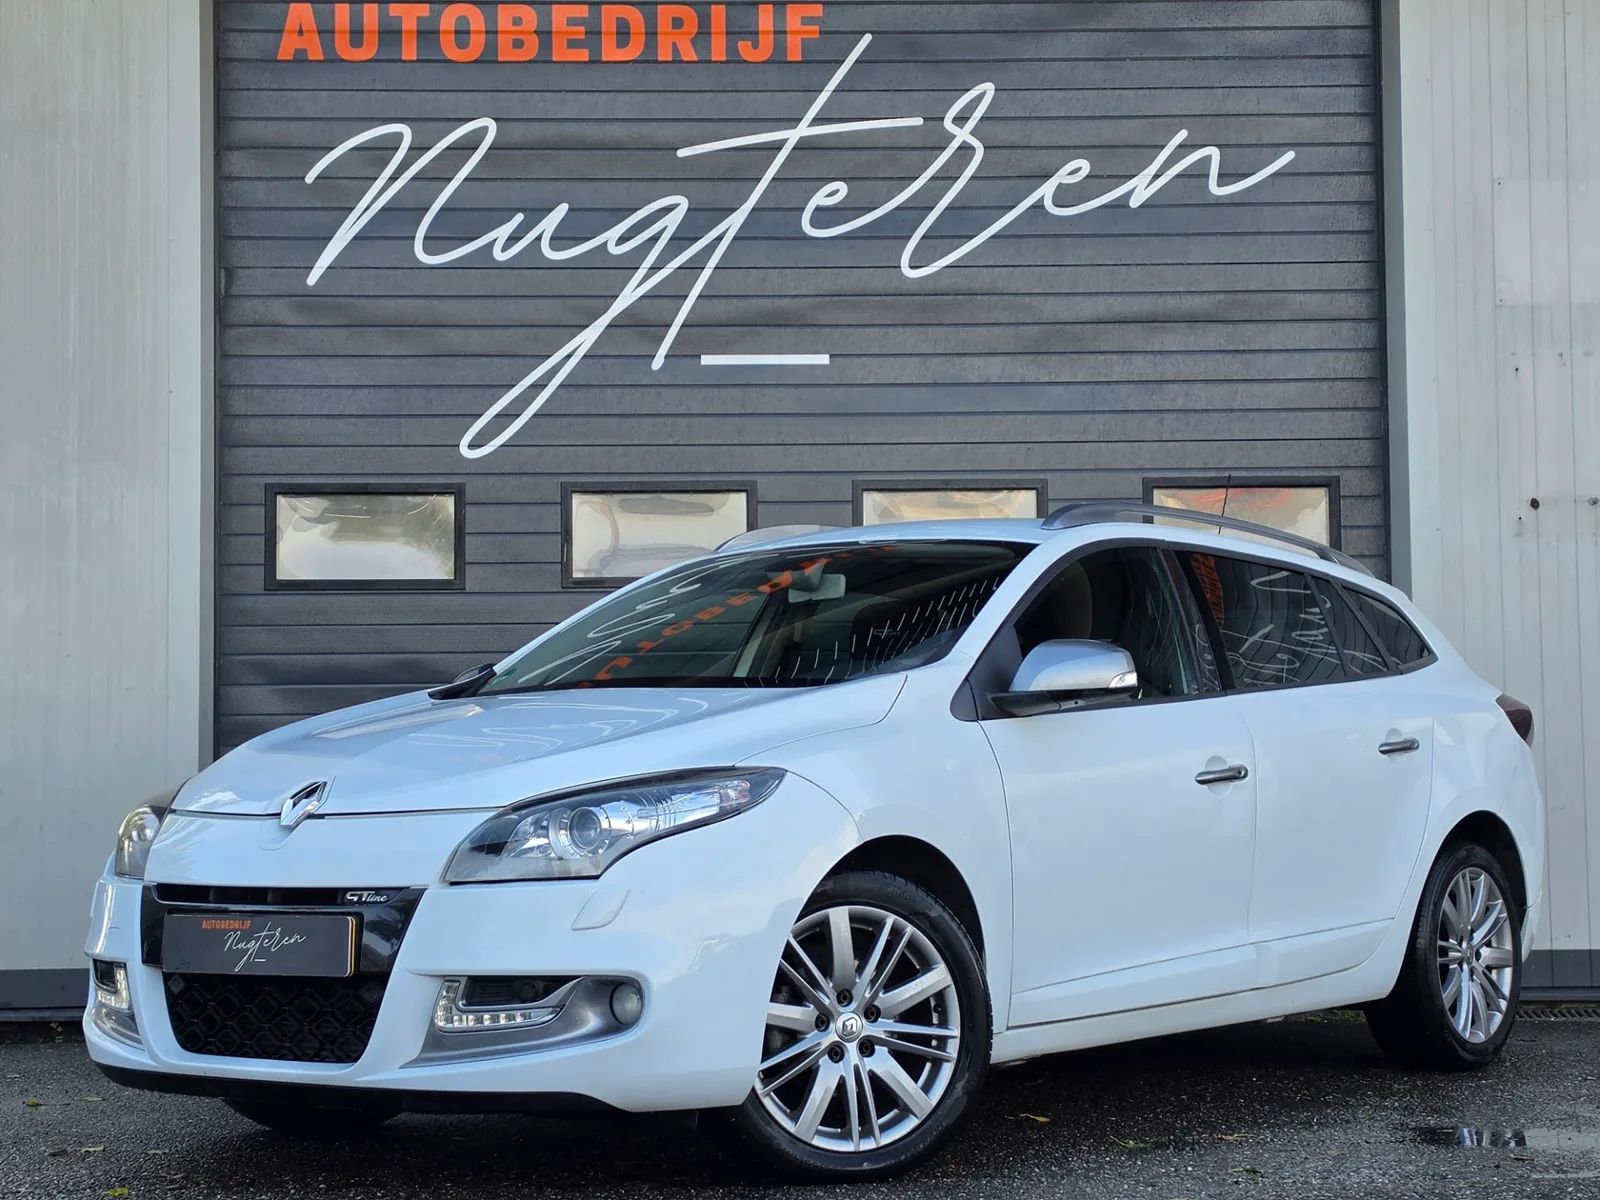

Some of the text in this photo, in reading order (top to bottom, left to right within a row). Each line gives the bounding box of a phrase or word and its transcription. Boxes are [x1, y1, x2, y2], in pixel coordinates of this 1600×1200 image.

[278, 3, 823, 63] AUTOBEDRIJF
[304, 33, 1296, 459] Nugteren
[201, 920, 252, 930] AUTOBEDRIJF
[224, 921, 307, 972] Nugteren
